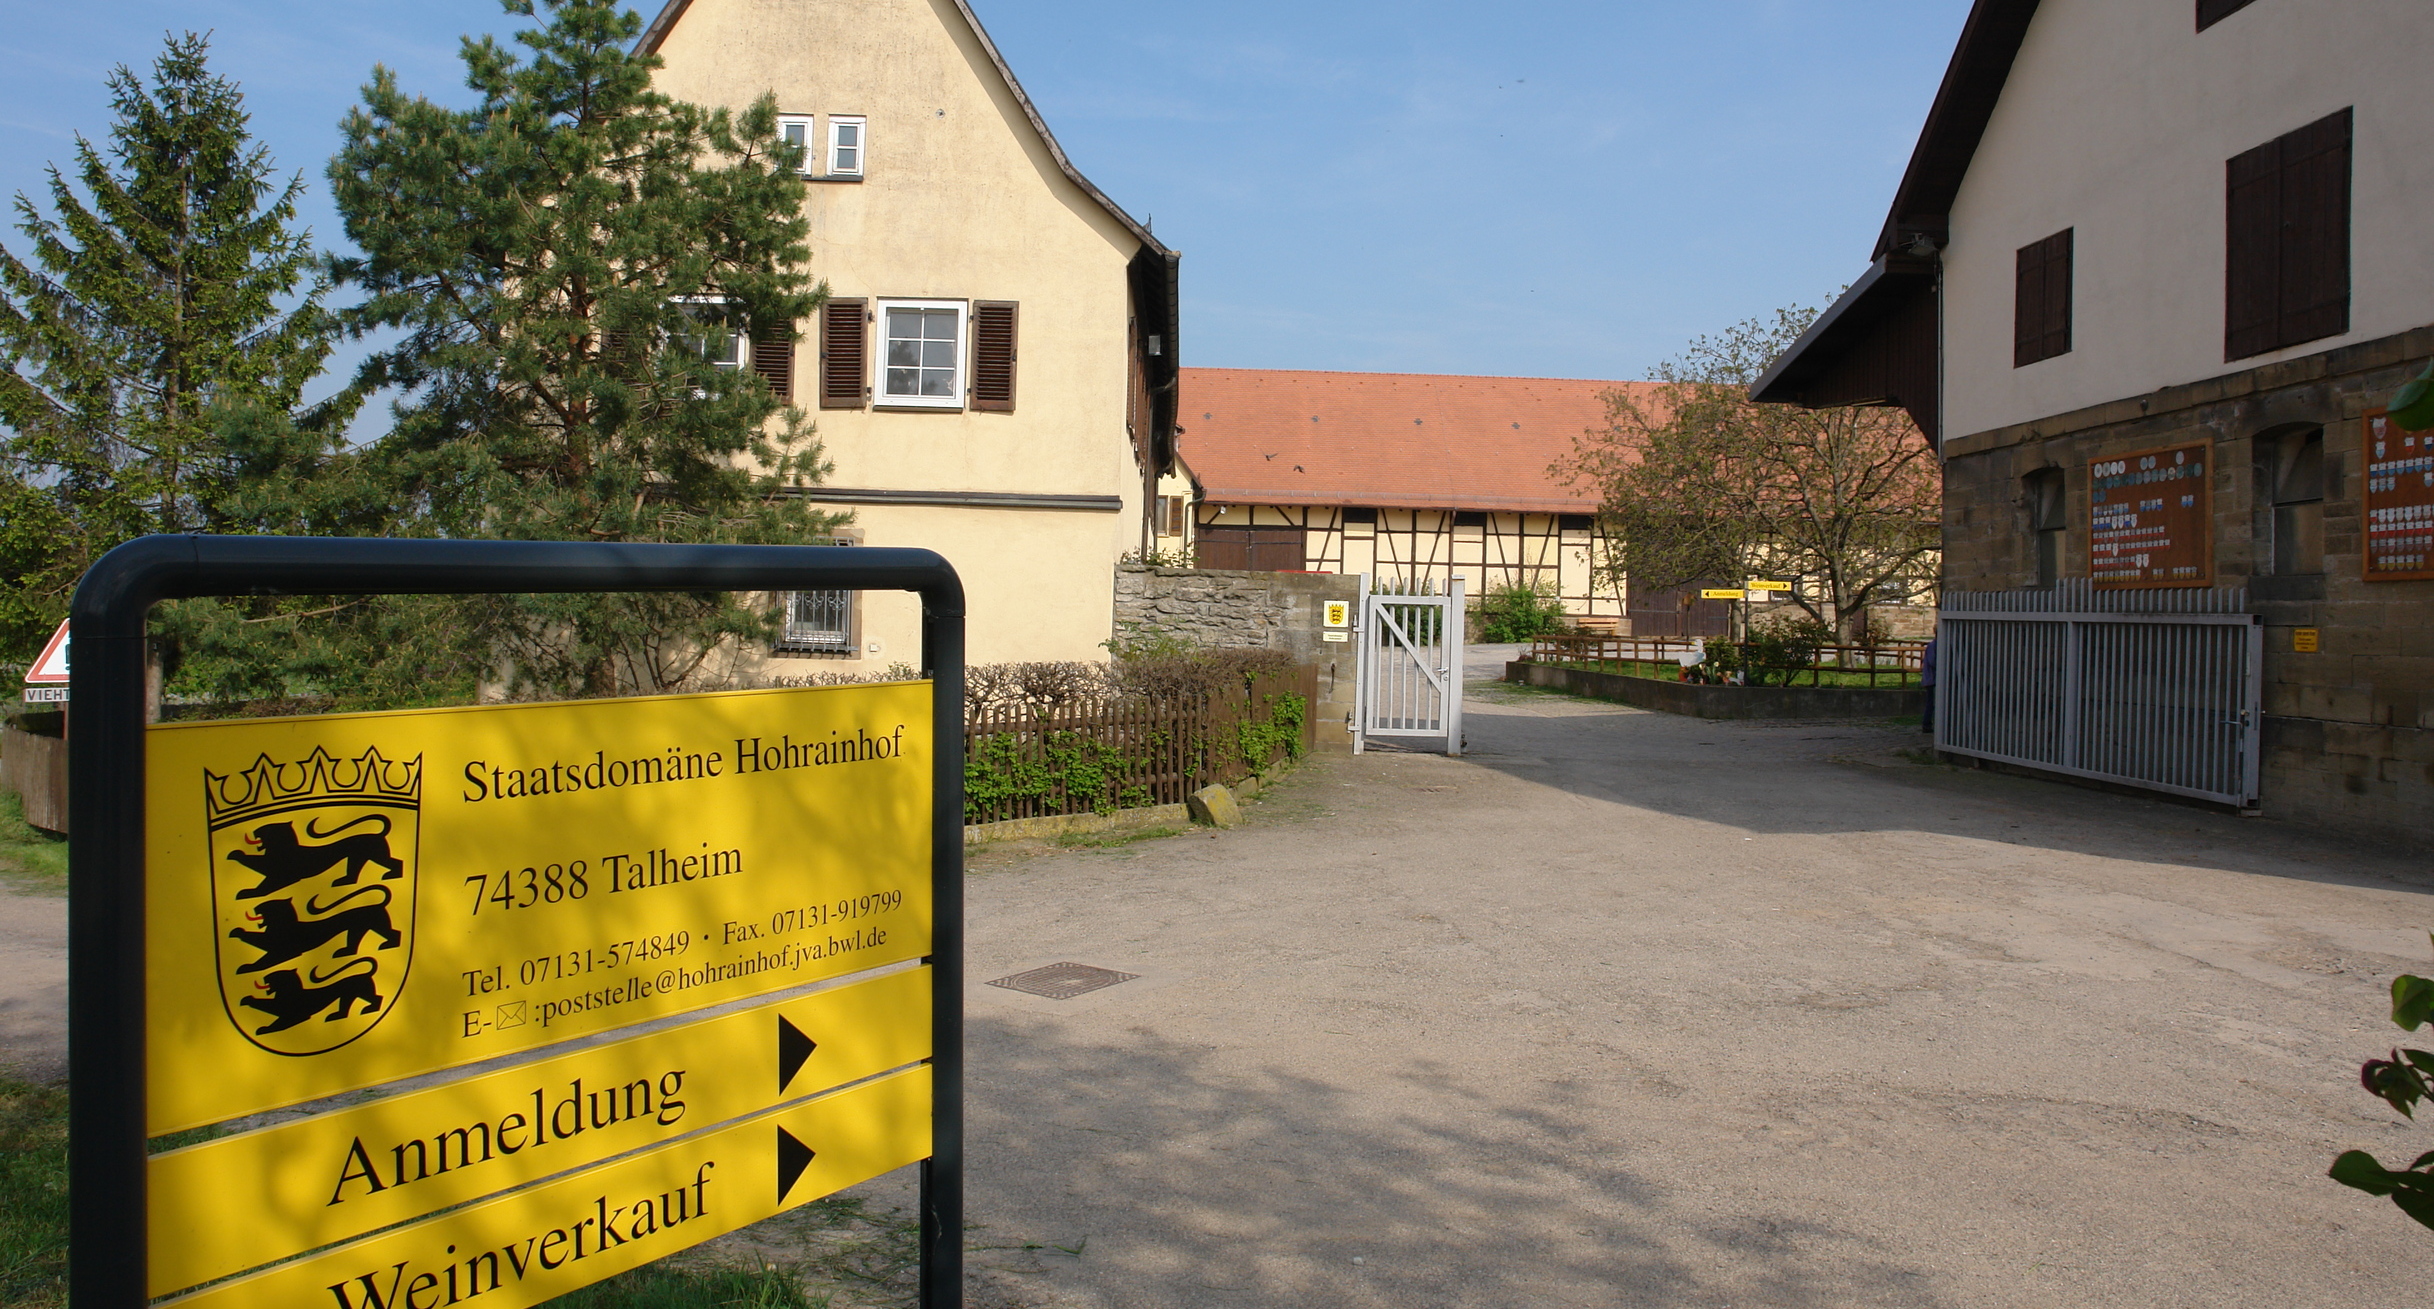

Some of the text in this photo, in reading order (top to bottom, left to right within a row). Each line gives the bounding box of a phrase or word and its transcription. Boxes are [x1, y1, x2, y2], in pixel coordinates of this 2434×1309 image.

[27, 689, 70, 701] VIEHT
[463, 724, 905, 803] Staatsdomäne Hohrainhof
[464, 842, 743, 916] 74388 Talheim
[462, 889, 902, 997] Tel. 07131-574849 Fax. 07131-919799
[326, 1069, 686, 1207] Anmeldung
[327, 1160, 715, 1309] Weinverkauf
